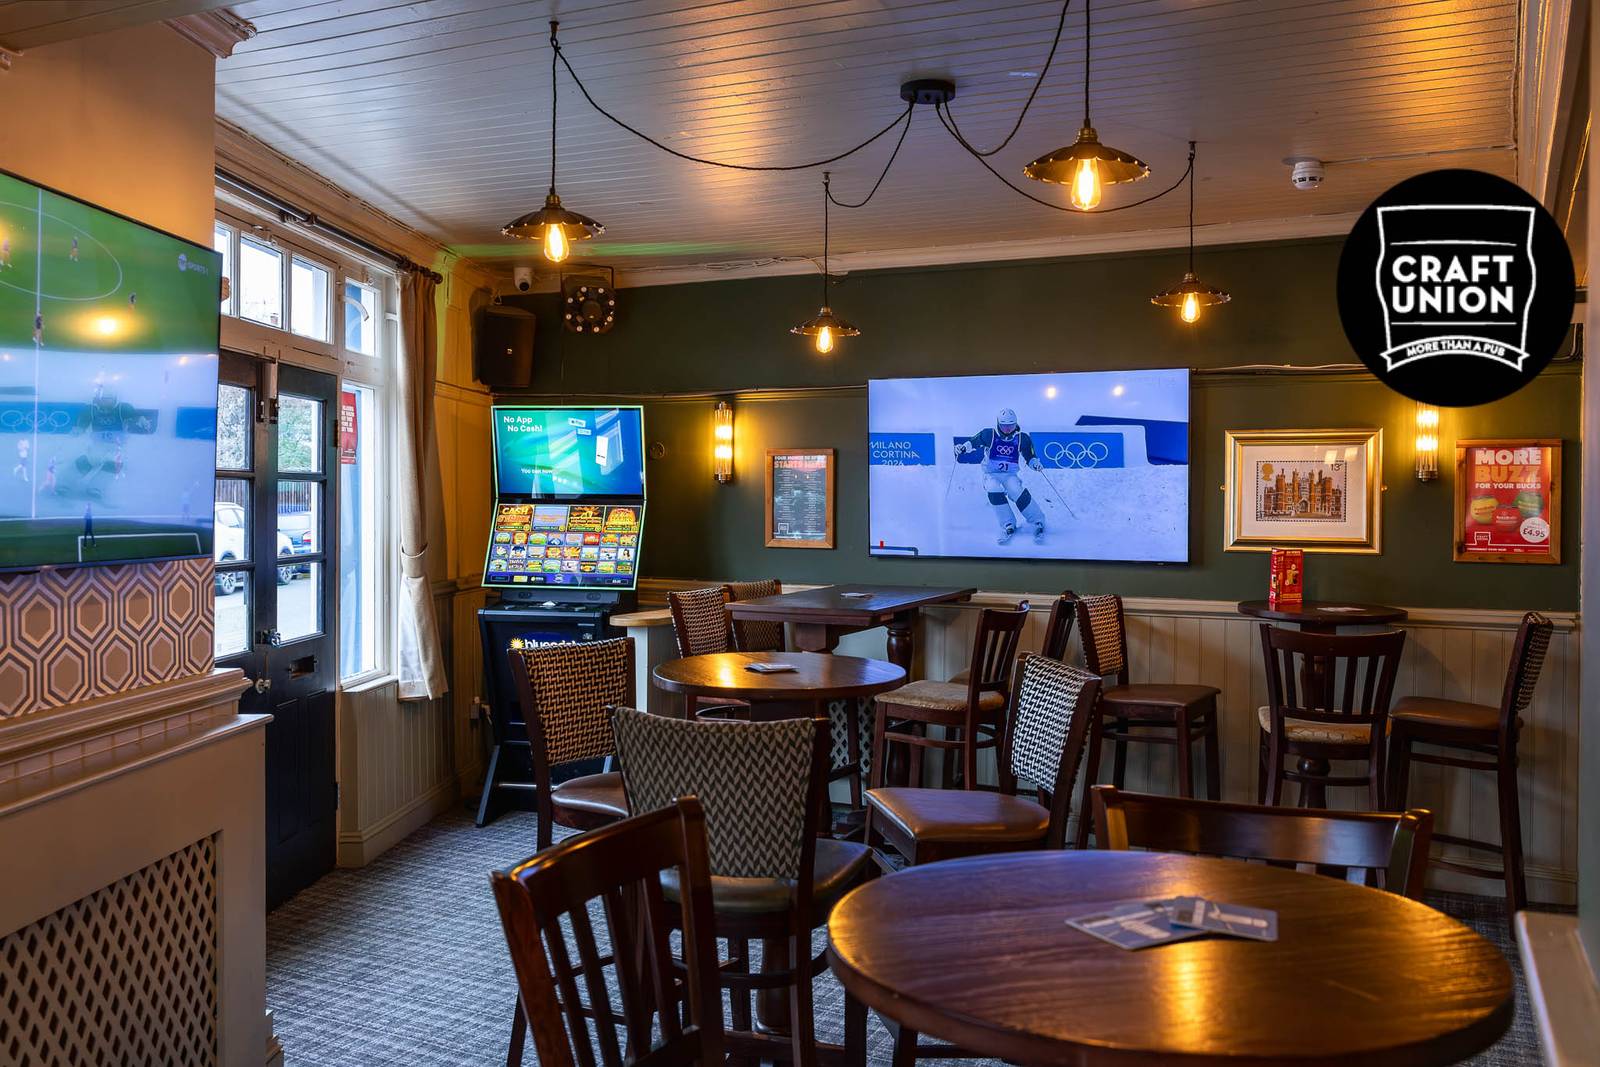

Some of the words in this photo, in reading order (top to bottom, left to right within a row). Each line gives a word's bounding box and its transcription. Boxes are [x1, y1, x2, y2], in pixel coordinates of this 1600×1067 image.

[503, 415, 515, 423] No
[516, 415, 533, 425] App
[507, 424, 519, 432] No
[520, 424, 543, 432] Cash!
[869, 441, 912, 450] MILANO
[872, 450, 921, 459] CORTINA
[1475, 449, 1542, 465] MORE
[998, 462, 1009, 473] 21
[1475, 465, 1541, 482] BUZZ
[1523, 528, 1545, 538] £4.95
